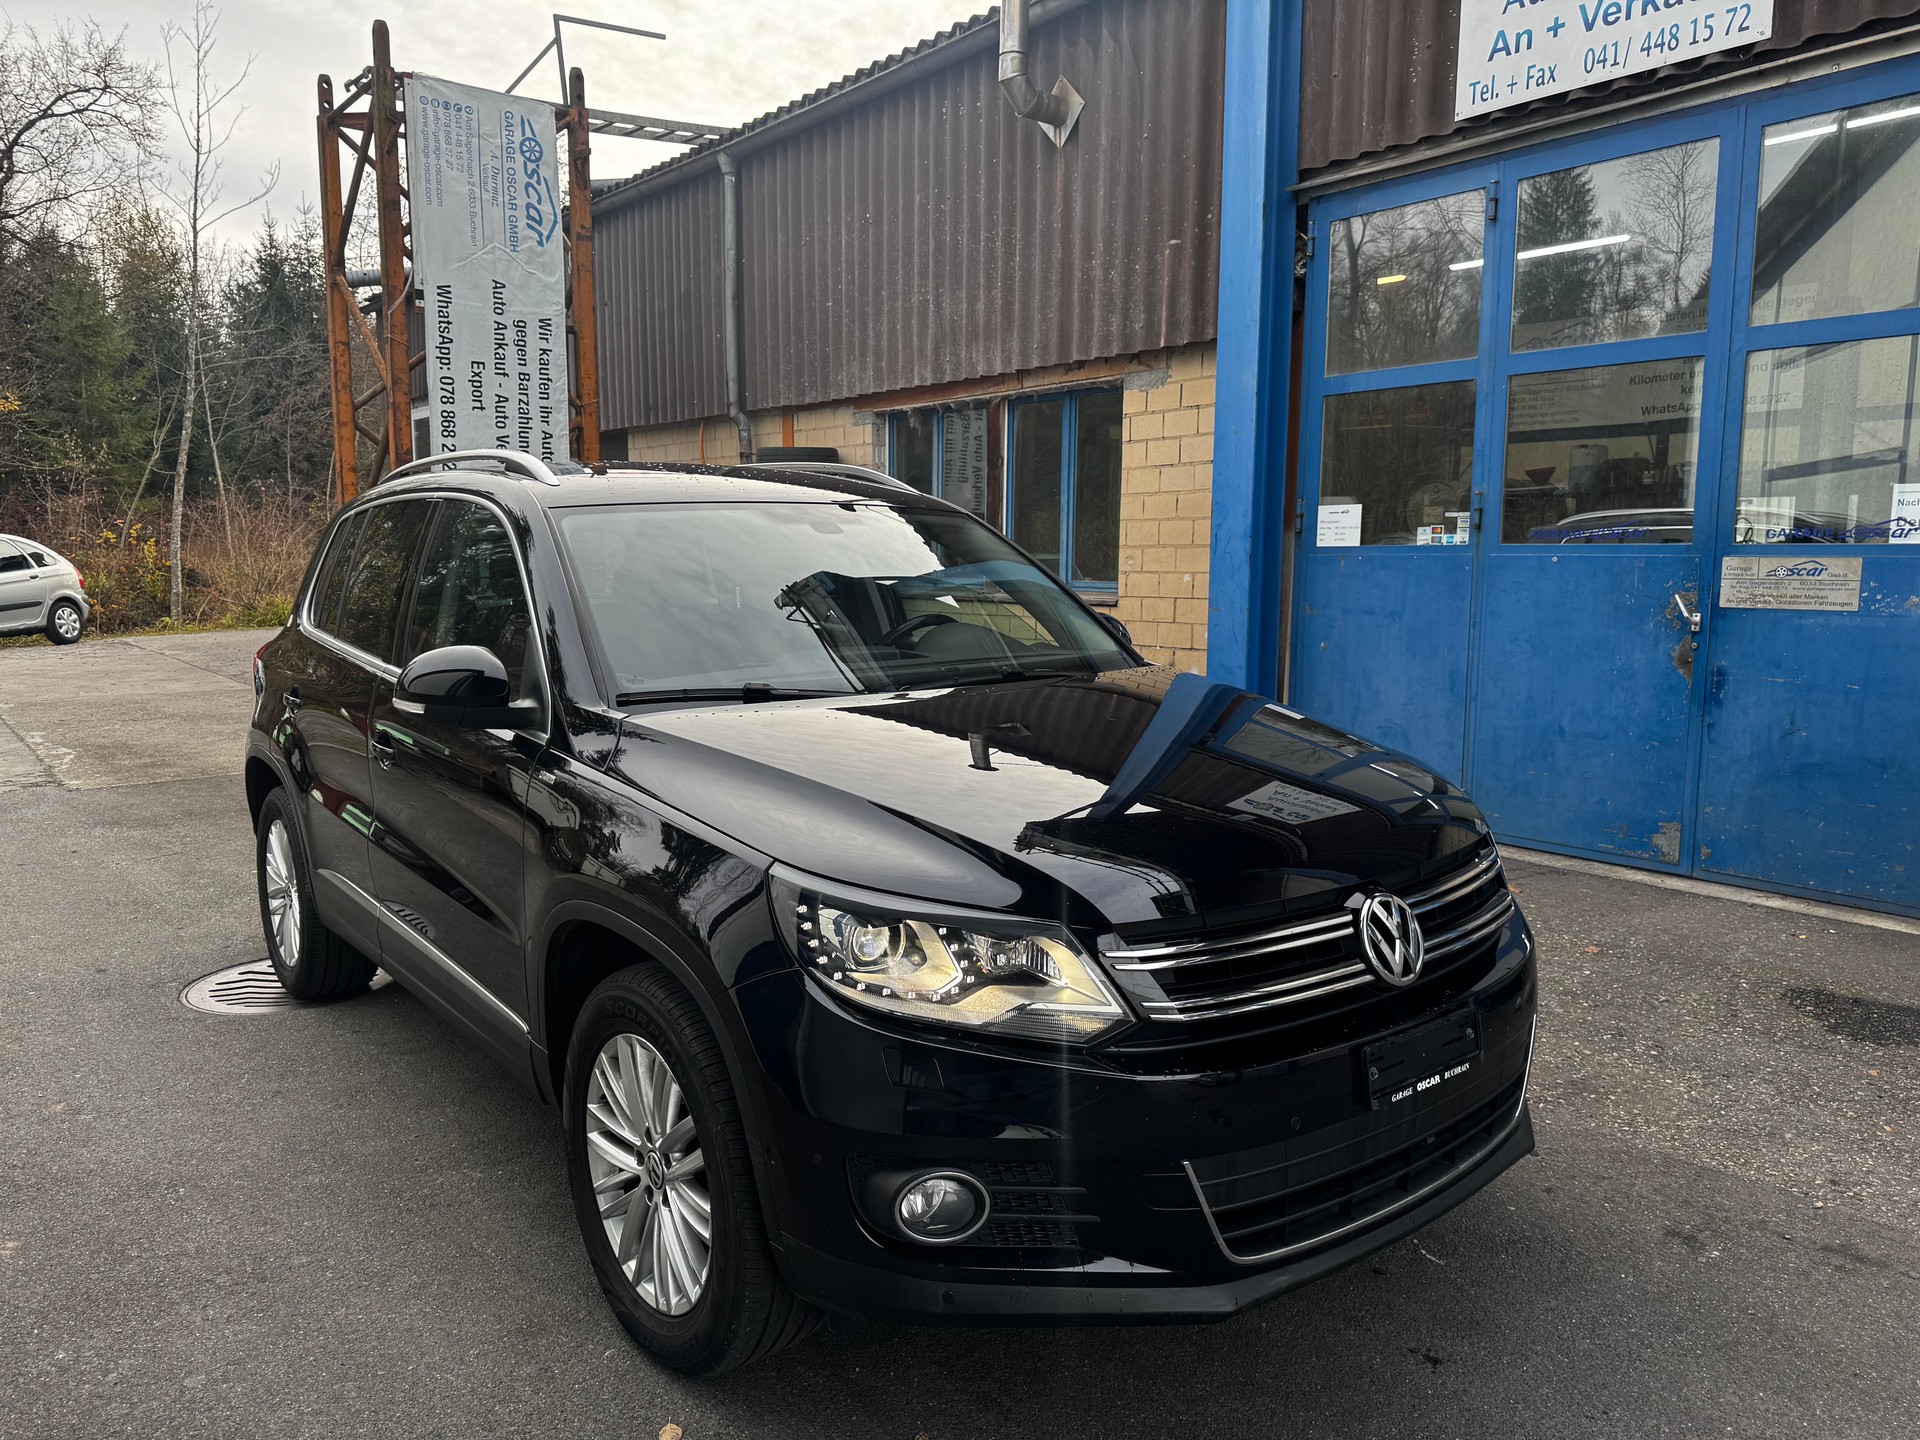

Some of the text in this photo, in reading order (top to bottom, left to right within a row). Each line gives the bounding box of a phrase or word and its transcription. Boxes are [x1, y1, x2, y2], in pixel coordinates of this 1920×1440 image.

[1469, 3, 1751, 105] Tel. + Fax 041/ 448 15 72
[1487, 28, 1533, 62] An
[1546, 16, 1565, 38] +
[454, 114, 462, 129] 041
[465, 116, 473, 130] Am
[421, 107, 432, 205] www.garage-oscar.com
[443, 112, 453, 170] 078 868 27 27
[456, 151, 463, 160] 15
[456, 162, 463, 173] 72
[482, 163, 490, 193] Verkauf
[504, 111, 518, 252] GARAGE OSCAR GMBH
[468, 189, 476, 209] 6033
[491, 165, 500, 208] Durmaz
[470, 211, 478, 247] Buchrain
[492, 279, 506, 316] Auto
[435, 285, 453, 371] WhatsApp:
[538, 318, 552, 344] Wir
[493, 320, 509, 378] Ankauf
[439, 376, 455, 405] 078
[468, 360, 485, 411] Export
[513, 319, 532, 453] gegen Barzahlun
[538, 348, 552, 400] kaufen
[1629, 372, 1685, 385] Kilometer
[440, 410, 456, 438] 868
[494, 394, 509, 429] Auto
[540, 406, 552, 426] ihr
[1766, 528, 1836, 540] GARAGE
[1391, 1086, 1413, 1102] GARAGE
[1417, 1074, 1441, 1092] OSCAR
